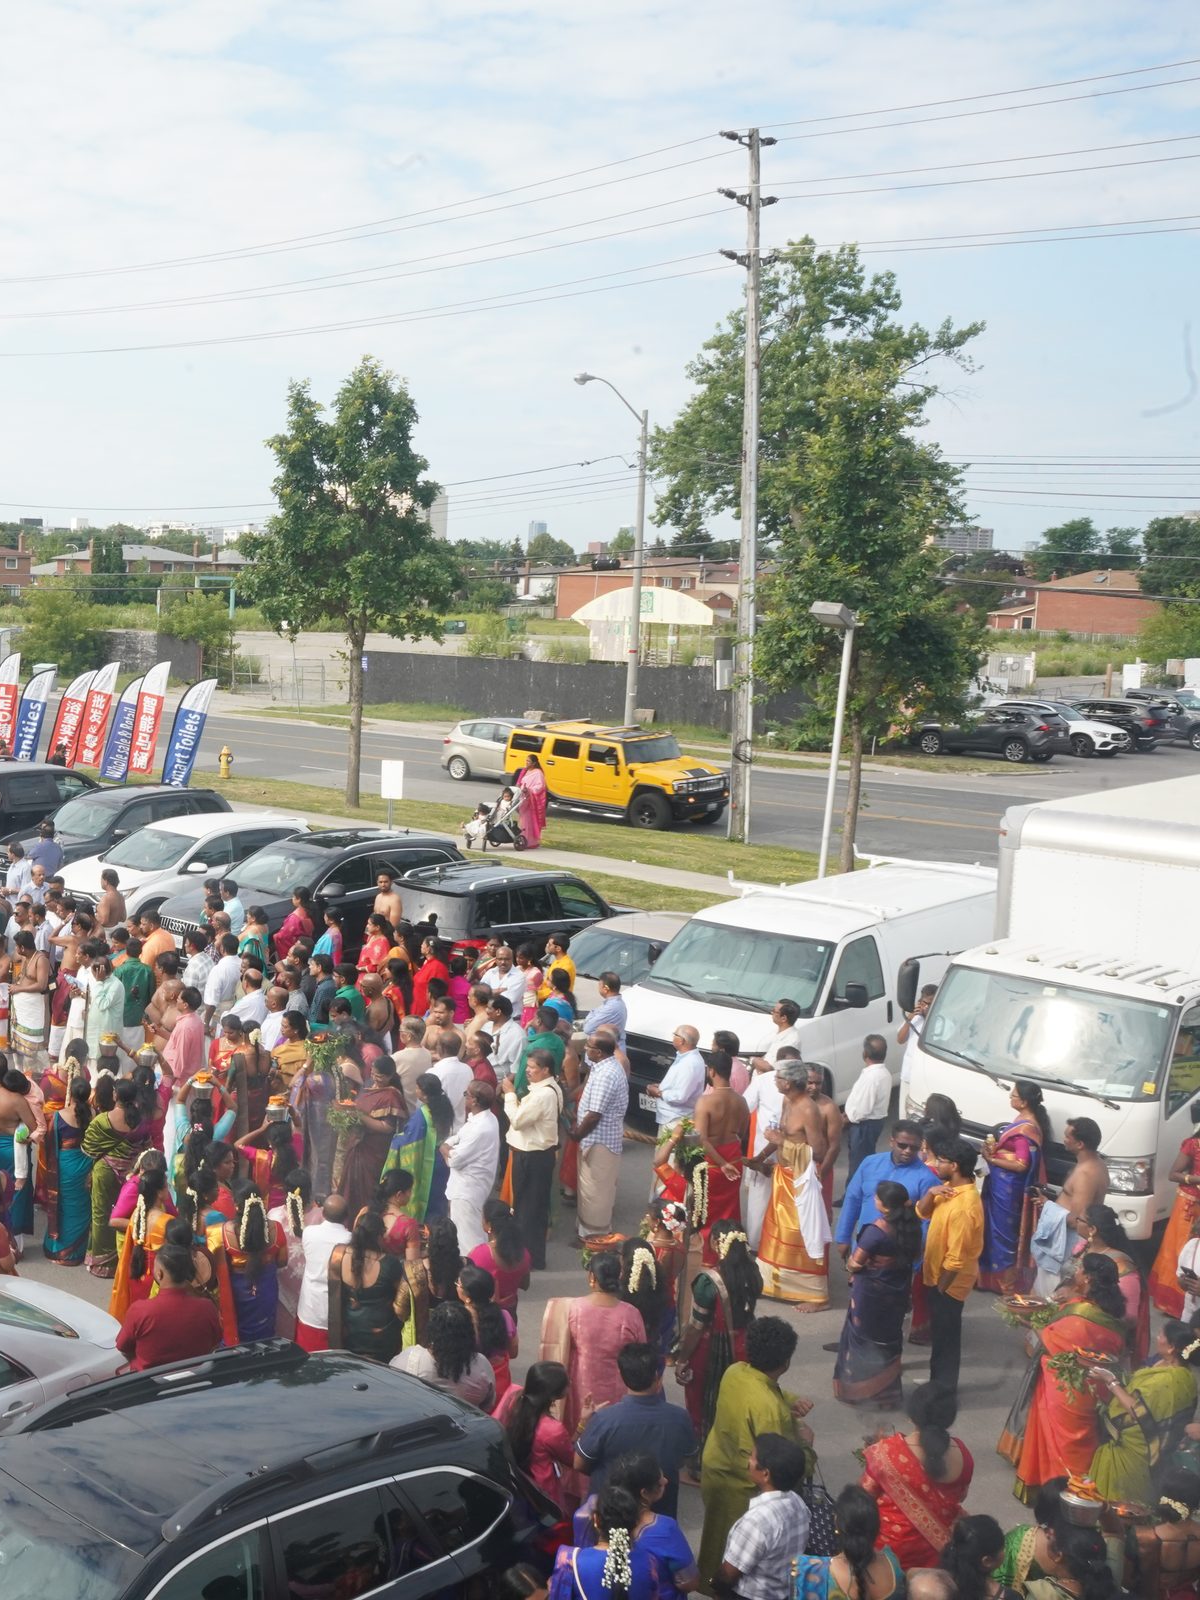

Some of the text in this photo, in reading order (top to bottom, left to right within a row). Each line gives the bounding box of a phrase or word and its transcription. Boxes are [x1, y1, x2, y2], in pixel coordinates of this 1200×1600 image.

[18, 702, 41, 760] anities
[119, 706, 137, 730] Retail
[132, 695, 158, 769] 智能马桶
[175, 713, 200, 750] Toilets
